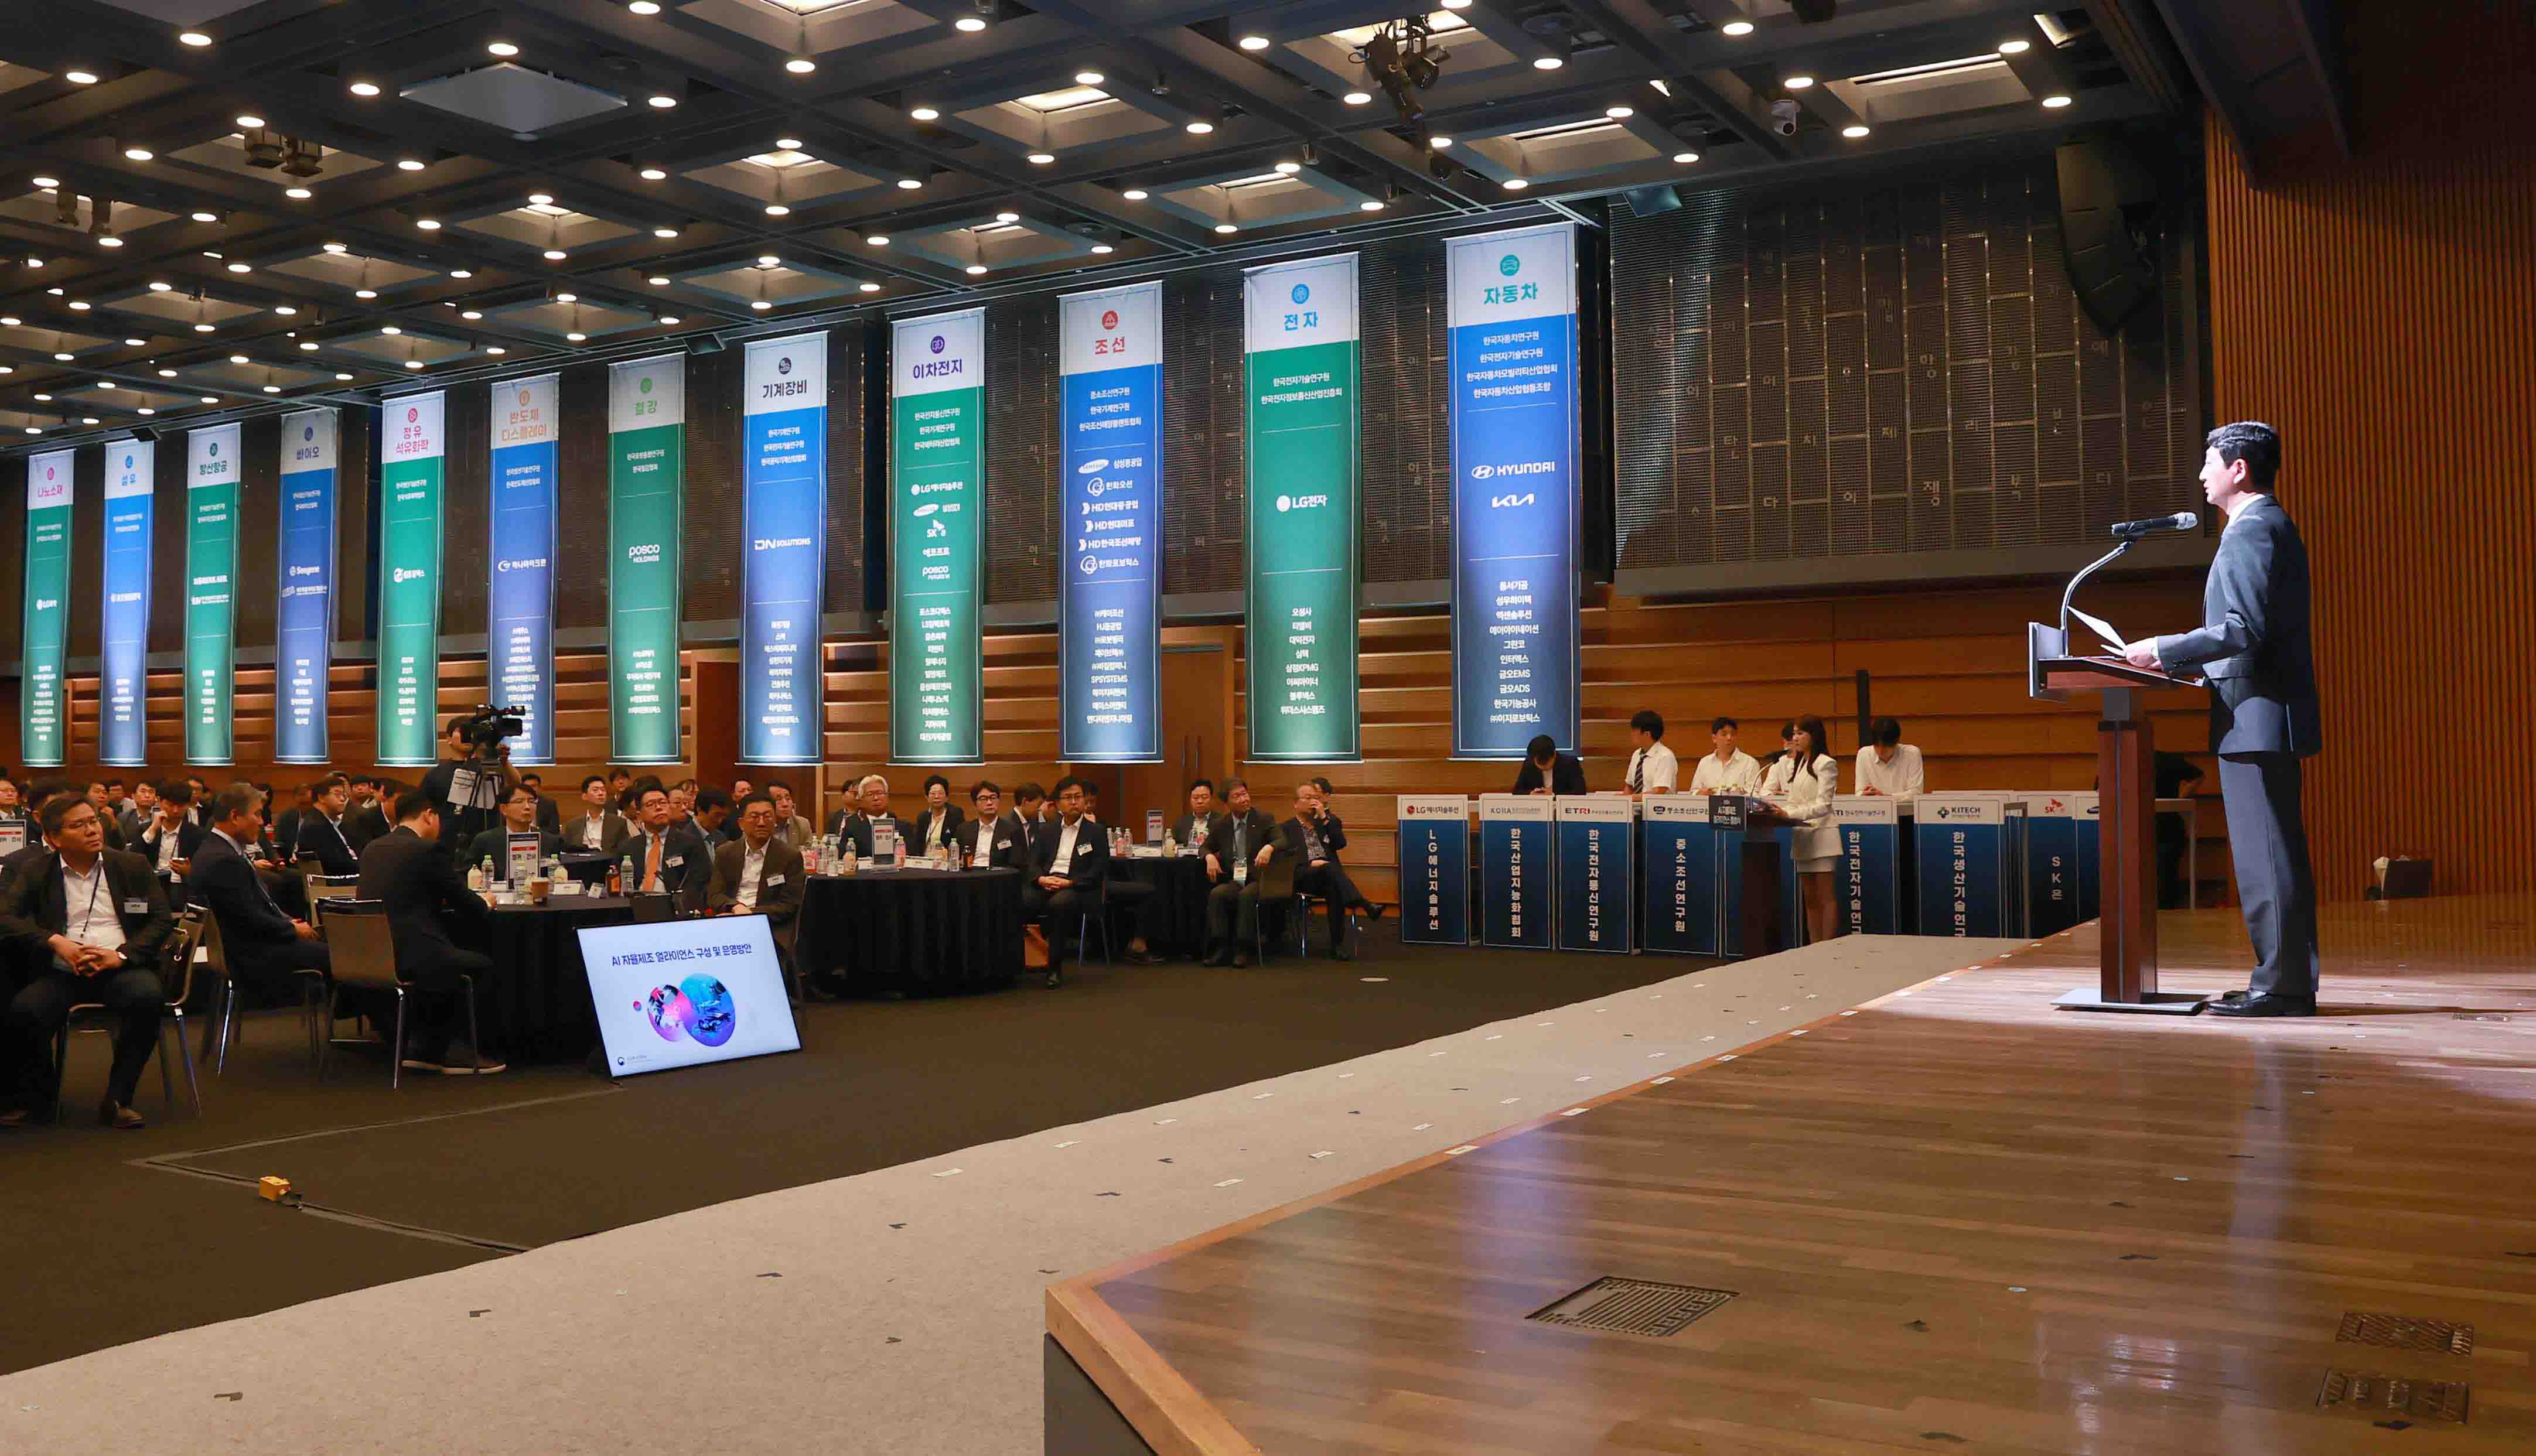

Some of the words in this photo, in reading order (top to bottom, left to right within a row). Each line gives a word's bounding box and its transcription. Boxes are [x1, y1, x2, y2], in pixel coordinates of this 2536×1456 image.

[1483, 282, 1538, 305] 자동차
[1483, 331, 1540, 346] 한국자동차연구원
[1480, 348, 1543, 363] 한국전자기술연구원
[913, 358, 962, 380] 이차전지
[763, 380, 807, 398] 기계장비
[510, 408, 539, 424] 반도체
[296, 446, 319, 460] 바이오
[1497, 461, 1555, 477] HYUNDAI
[1292, 494, 1327, 508] LG전자
[1491, 493, 1535, 508] KIA
[629, 544, 660, 559] posco
[1428, 829, 1439, 931] LG에너지솔루션
[1588, 829, 1600, 942] 한국전자통신연구원
[1675, 838, 1687, 932] 중소조선연구원
[2051, 856, 2063, 900] SK온
[612, 956, 621, 966] AI
[622, 952, 655, 965] 자율제조
[656, 949, 696, 962] 얼라이언스
[697, 947, 712, 958] 구성
[712, 946, 722, 957] 및
[722, 943, 753, 956] 운영방안
